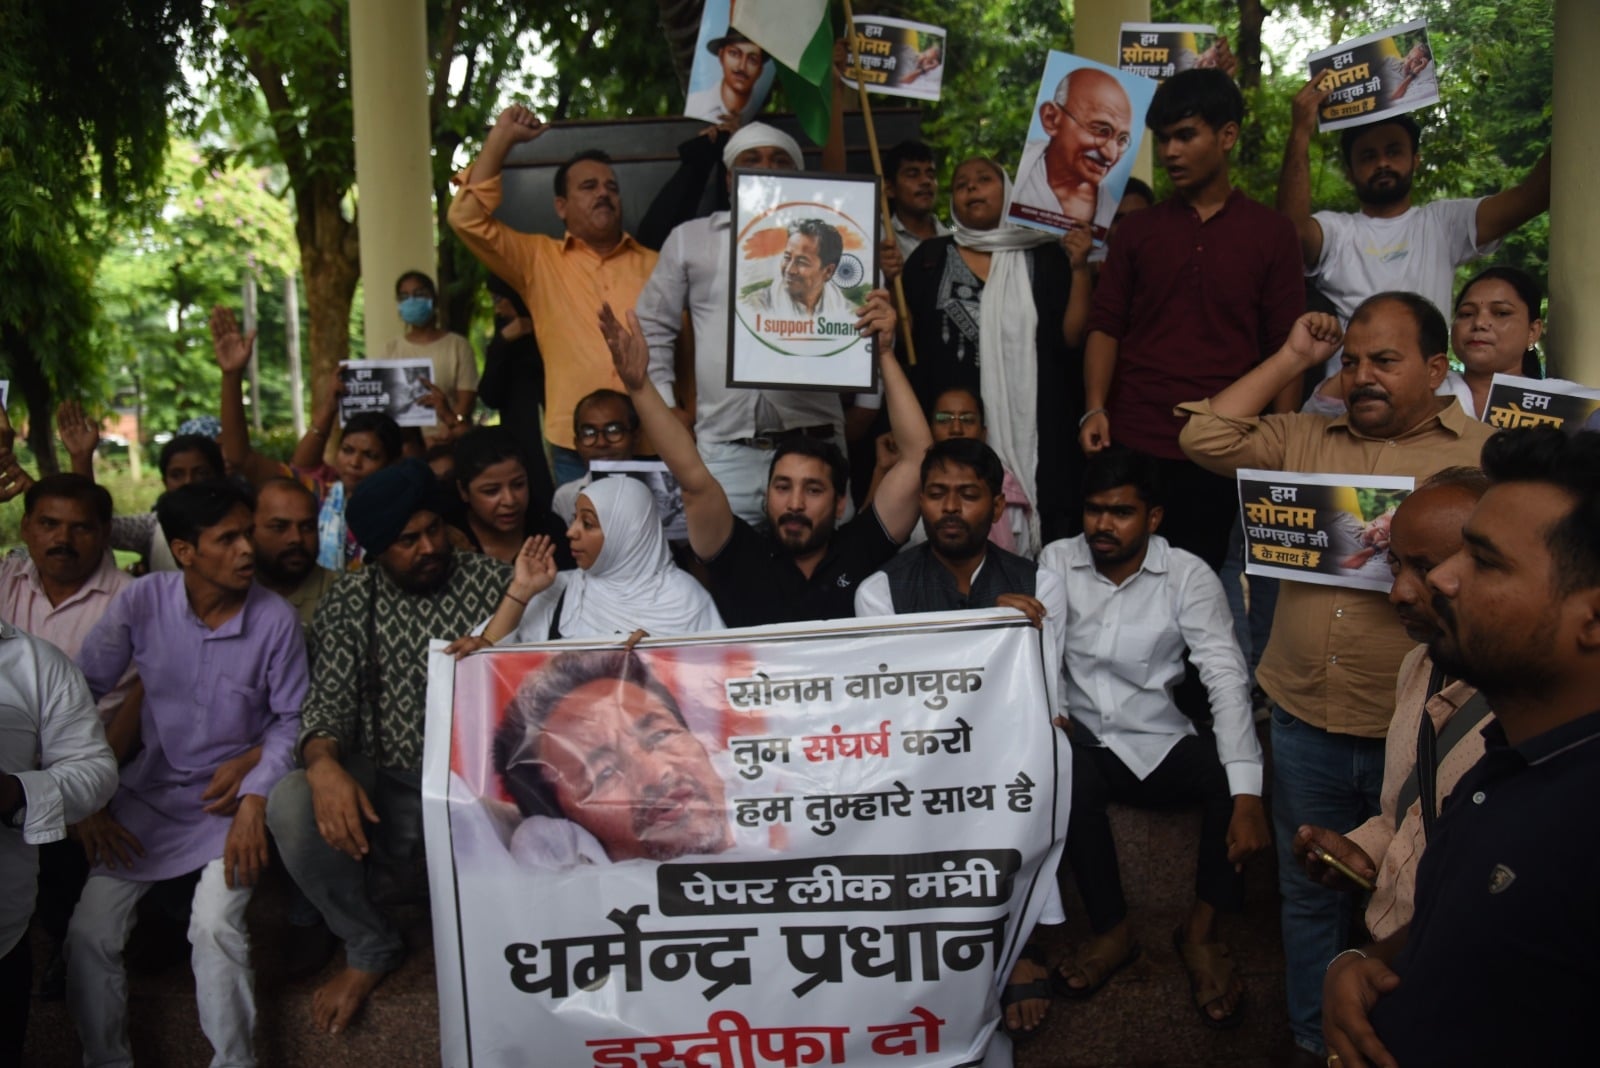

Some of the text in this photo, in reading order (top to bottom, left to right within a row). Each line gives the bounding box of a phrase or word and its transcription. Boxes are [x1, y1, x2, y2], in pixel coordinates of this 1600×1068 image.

[850, 32, 892, 56] ोनम
[1140, 33, 1159, 46] हम
[1122, 42, 1169, 63] सोनम
[1332, 52, 1353, 69] हम
[1161, 62, 1175, 77] जी
[1365, 76, 1381, 92] जी
[755, 314, 761, 332] I
[764, 318, 815, 336] support
[1522, 392, 1551, 409] हम
[1269, 486, 1297, 502] हम
[1245, 497, 1316, 529] सोनम
[1247, 524, 1328, 547] वांगचुक जी
[1261, 547, 1272, 559] के
[1275, 551, 1299, 563] साथ
[728, 663, 985, 710] सोनम वांगचुक
[731, 717, 973, 780] तुम संघर्ष करो
[735, 771, 1035, 836] हम तुम्हारे साथ है
[680, 857, 1000, 906] पेपर लीक मंत्री
[503, 904, 1010, 1001] धर्मेन्द्र प्रधान
[866, 1006, 946, 1055] दो
